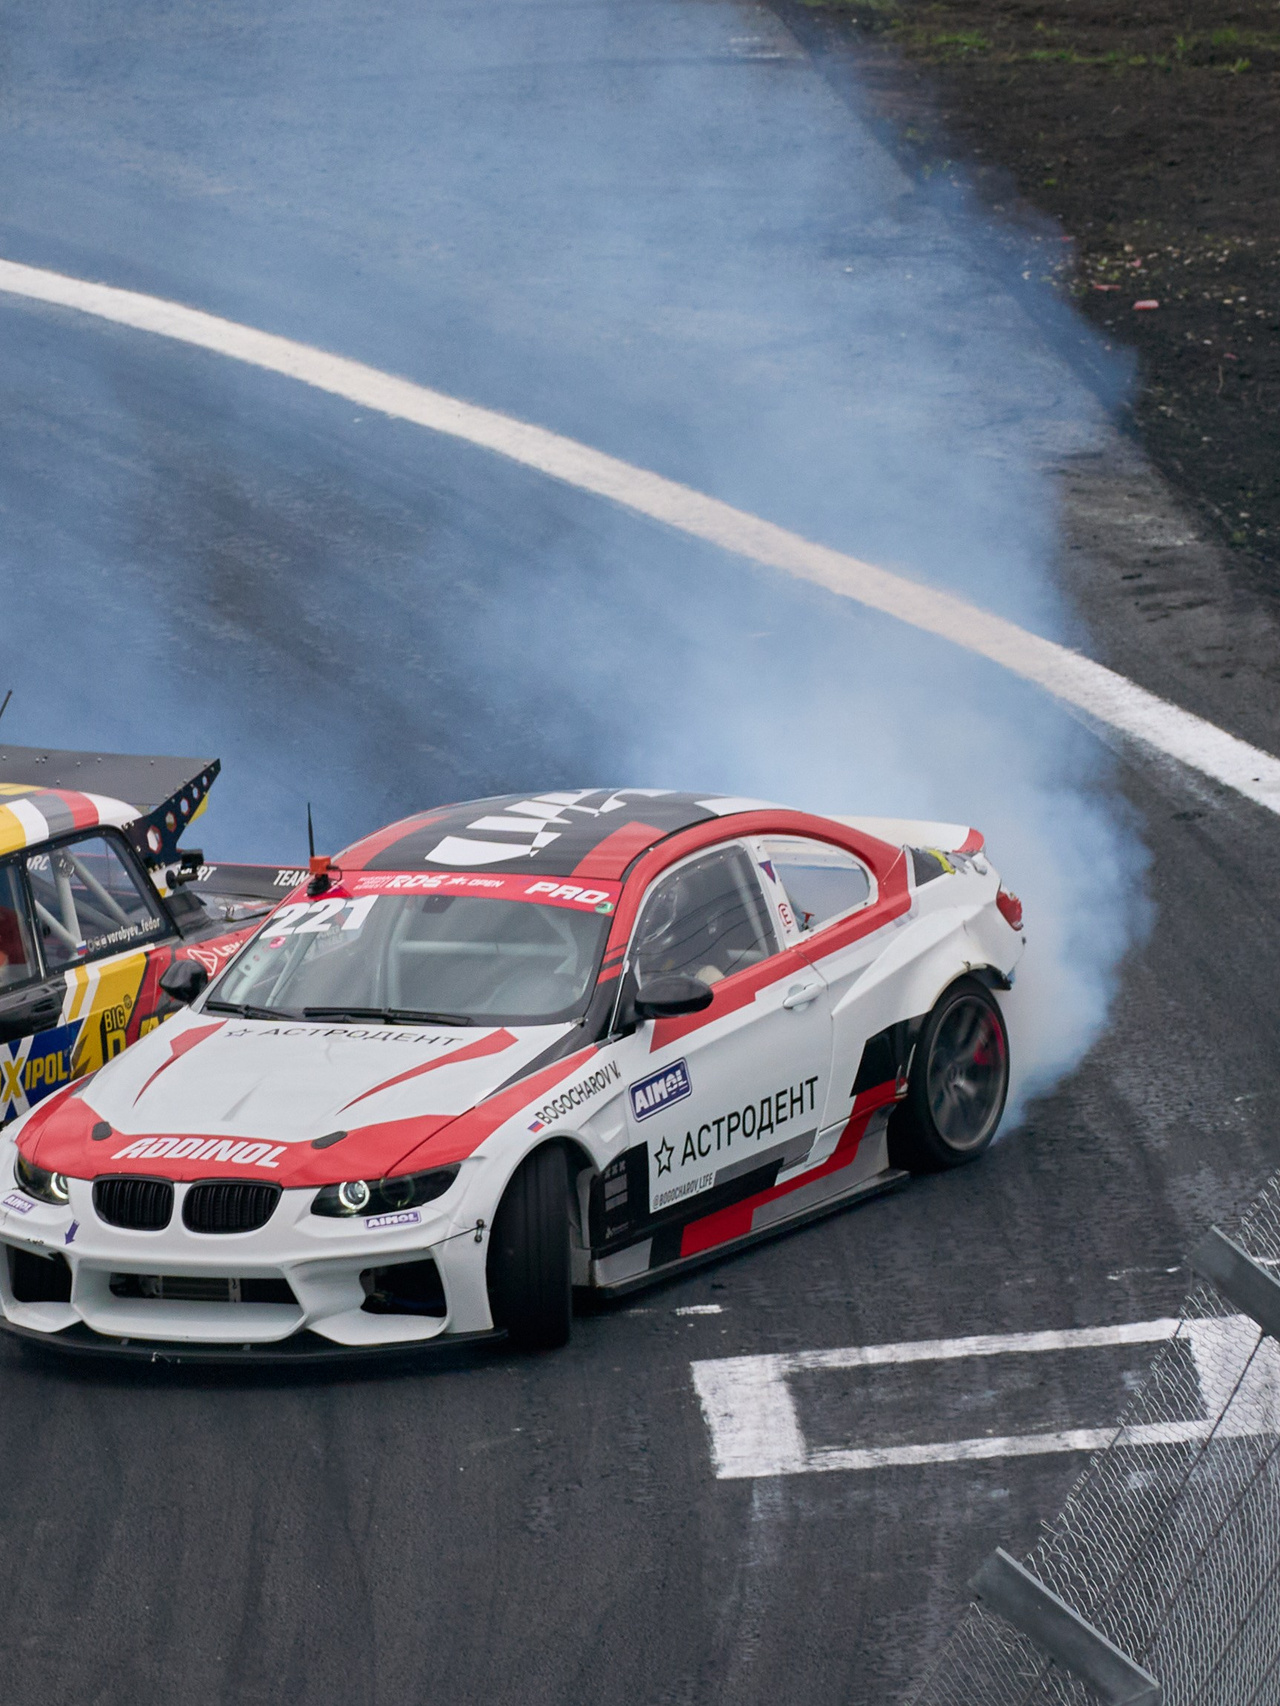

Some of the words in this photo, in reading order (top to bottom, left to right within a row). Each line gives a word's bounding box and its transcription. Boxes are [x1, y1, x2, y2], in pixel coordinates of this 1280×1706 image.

[385, 874, 452, 889] RDS
[468, 878, 505, 889] OPEN
[524, 881, 610, 904] PRO
[259, 894, 380, 940] 221
[104, 1006, 126, 1032] BIG
[258, 1027, 464, 1047] АСТРОДЕНТ
[535, 1065, 613, 1125] BOGOCHAROV
[635, 1069, 688, 1113] AIMOL
[681, 1075, 819, 1167] АСТРОДЕНТ
[110, 1137, 288, 1168] ADDINOL
[367, 1213, 418, 1228] AIMOL
